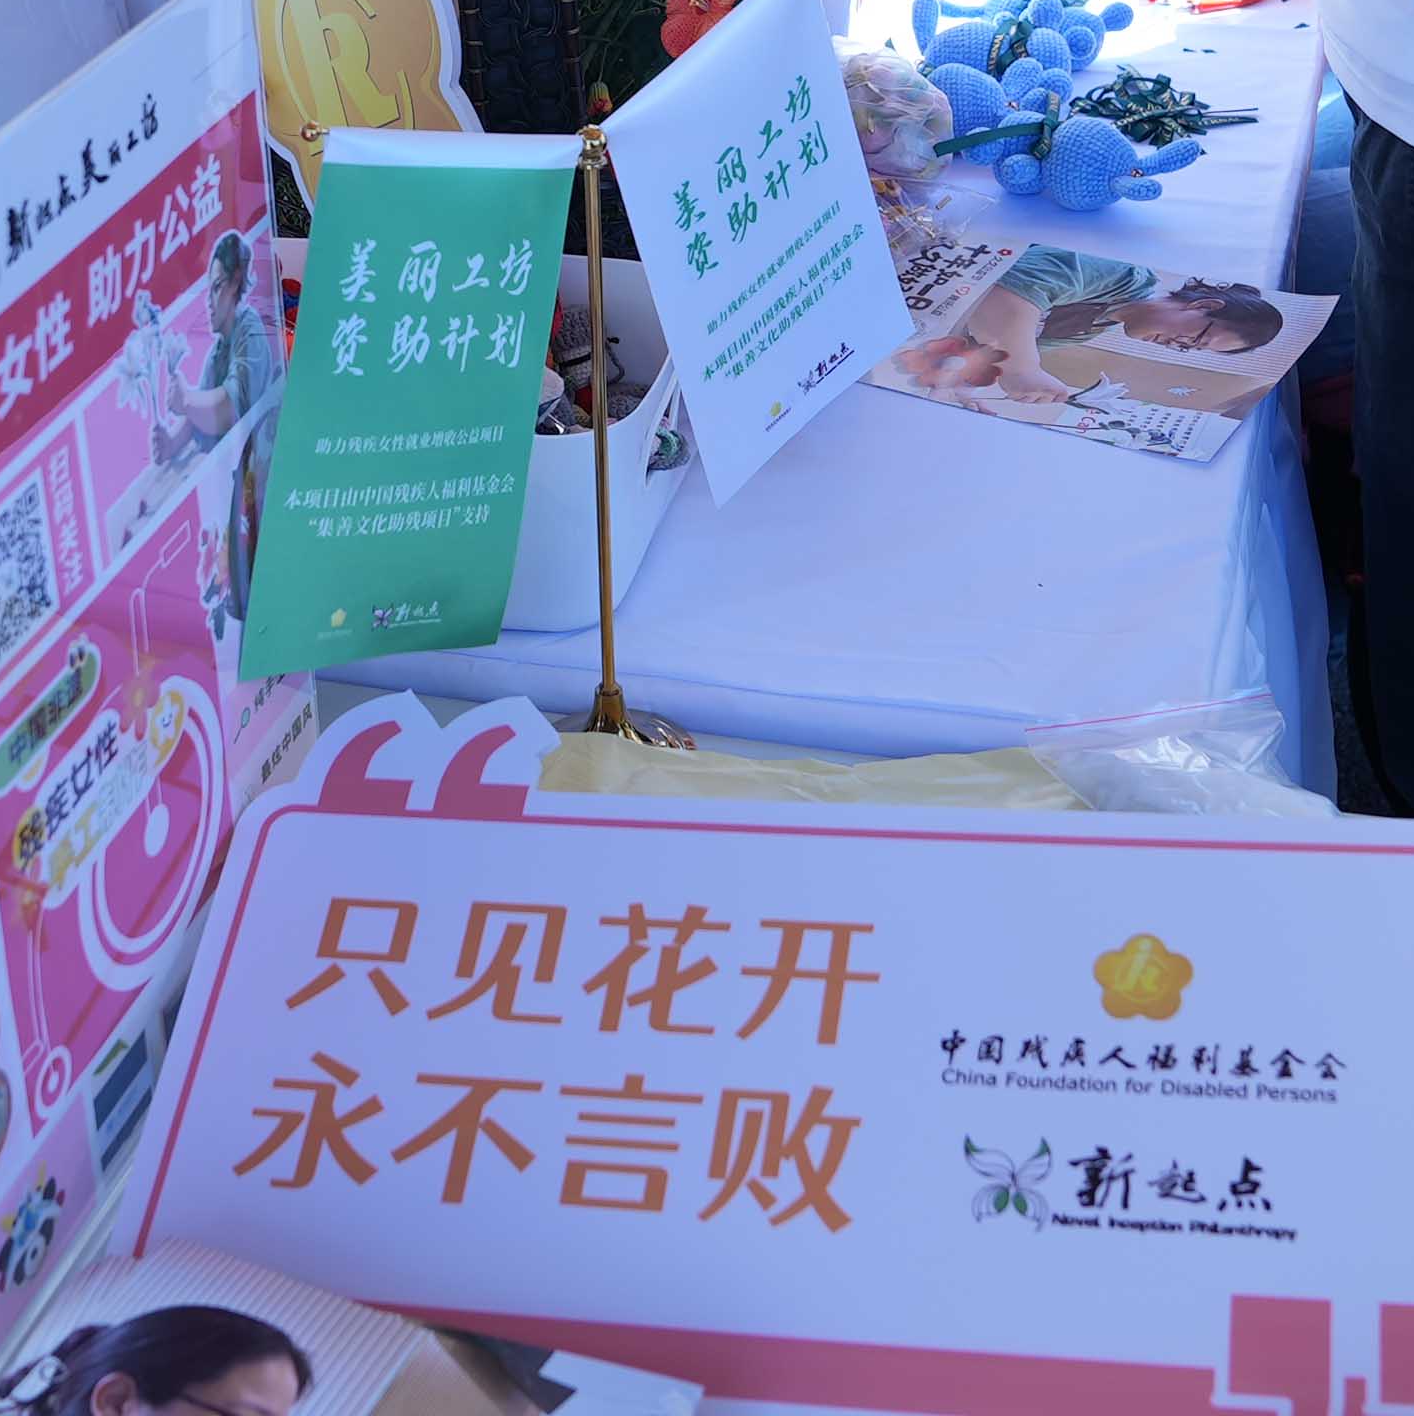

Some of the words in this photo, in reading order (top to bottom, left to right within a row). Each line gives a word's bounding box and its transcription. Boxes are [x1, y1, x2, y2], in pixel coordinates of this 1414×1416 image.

[673, 75, 813, 232] 美丽工坊
[685, 127, 831, 281] 资助计划
[87, 153, 223, 332] 助力公益
[339, 237, 534, 304] 美丽工坊
[904, 243, 992, 311] 十年如一日
[331, 310, 526, 376] 资助计划
[284, 473, 516, 511] 本项目由中国残疾人福利基金会
[285, 896, 881, 1048] 只见花开
[940, 1029, 1347, 1081] 中国残疾人福利基金会
[941, 1067, 999, 1088] China
[1005, 1071, 1119, 1095] Foundation
[1125, 1077, 1153, 1096] for
[1161, 1079, 1249, 1101] Disabled
[1256, 1084, 1338, 1104] Persons
[231, 1049, 862, 1236] 永不言败
[1068, 1145, 1274, 1213] 新起点
[1051, 1212, 1100, 1230] Novel
[1108, 1214, 1183, 1237] Inception
[1189, 1219, 1299, 1244] Philanthropy
